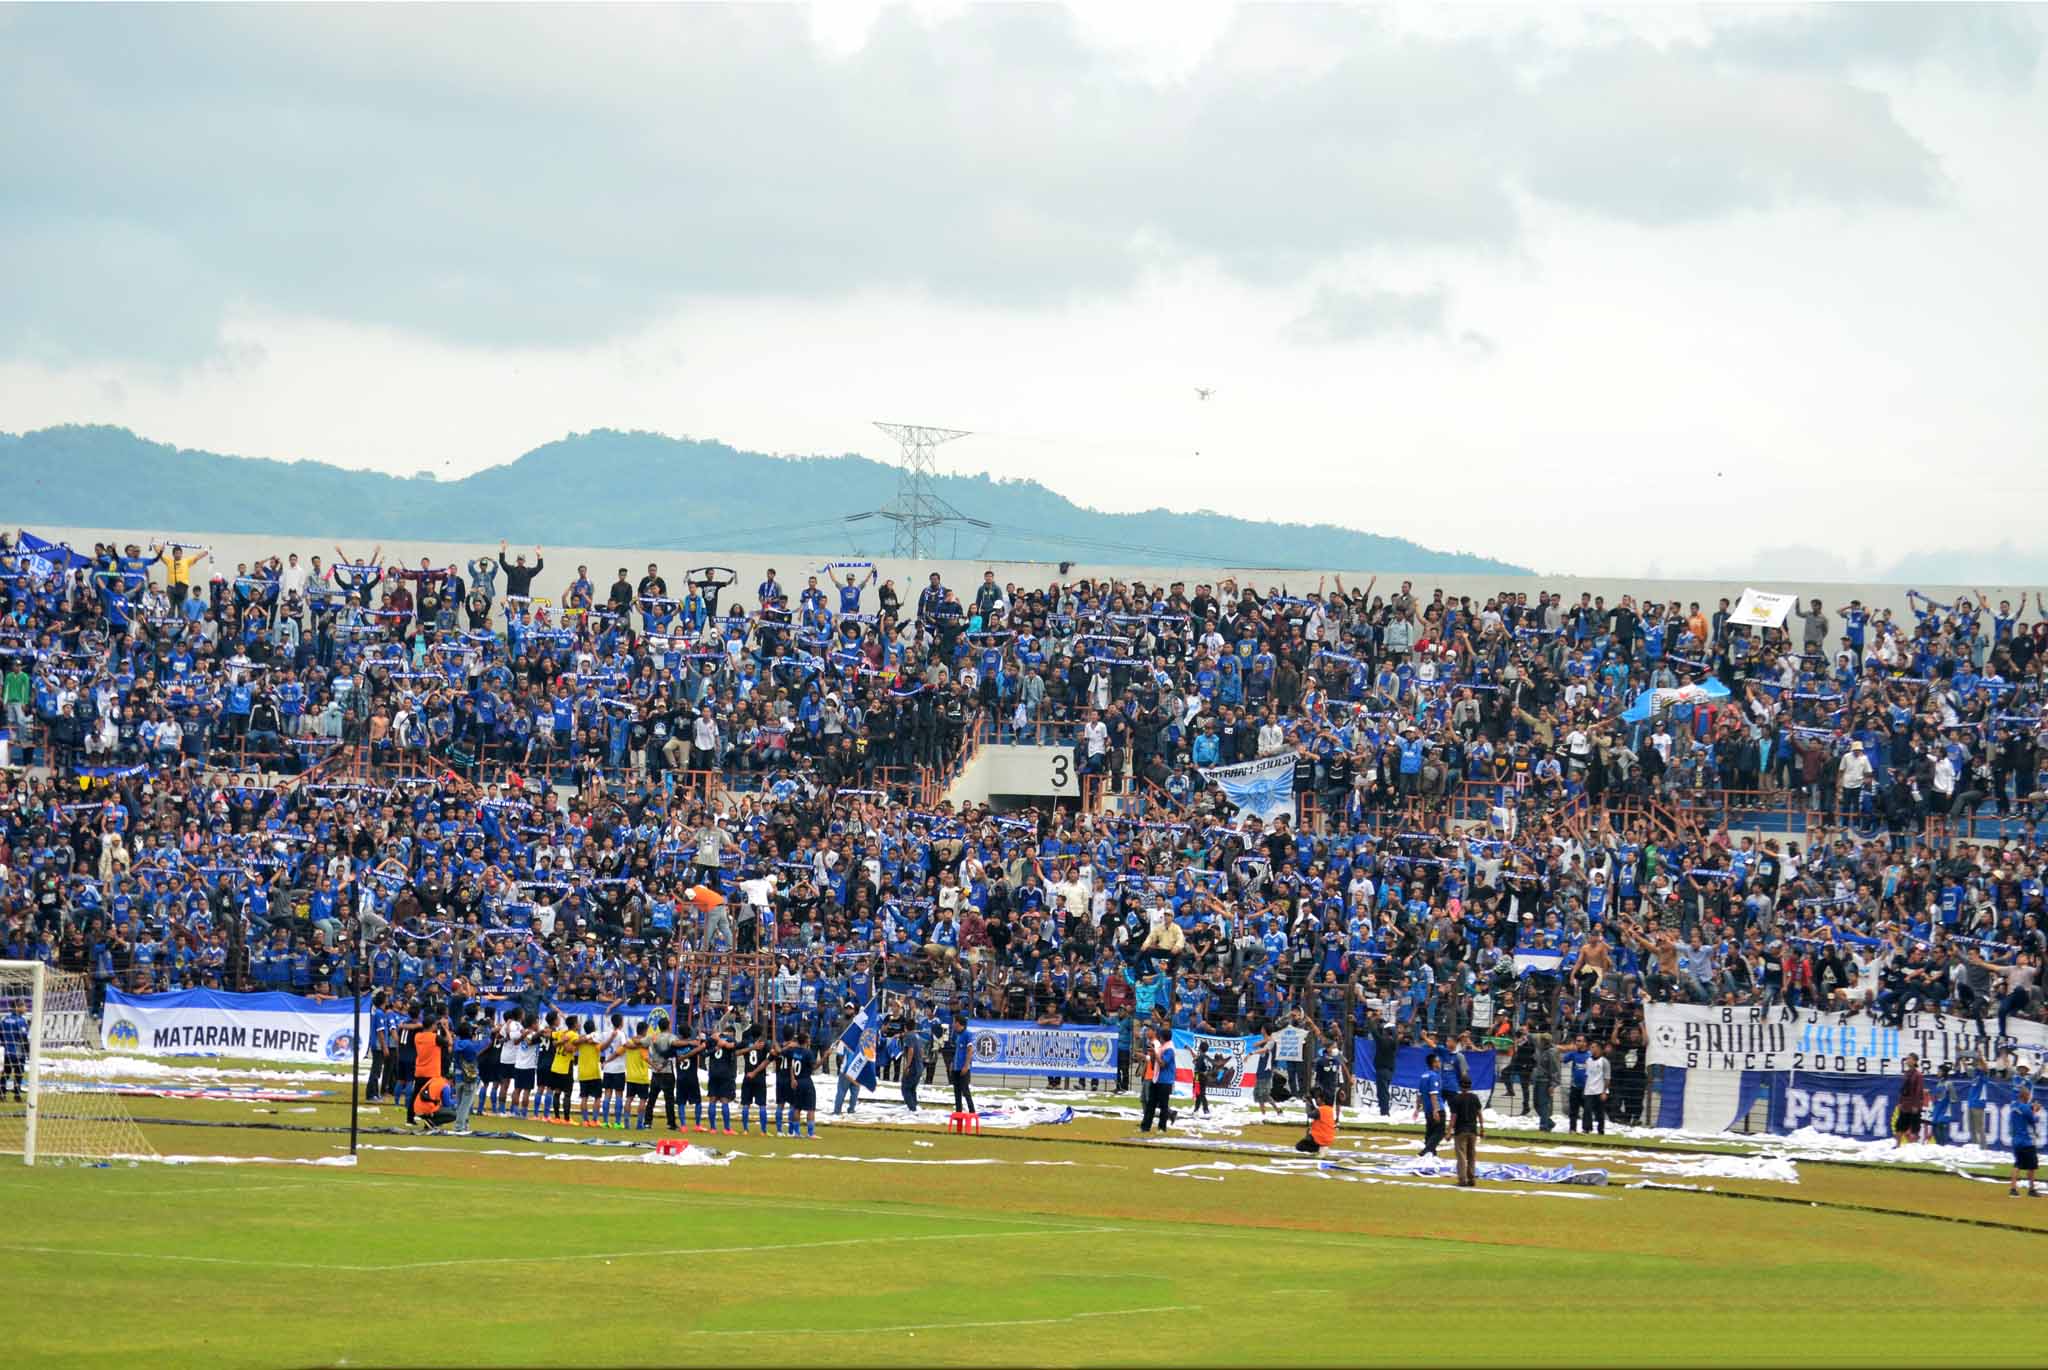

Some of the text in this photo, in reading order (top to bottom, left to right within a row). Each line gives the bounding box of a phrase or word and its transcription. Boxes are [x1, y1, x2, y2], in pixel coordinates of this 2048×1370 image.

[1051, 754, 1069, 787] 3
[153, 1026, 320, 1053] MATARAM EMPIRE
[1687, 1053, 1775, 1069] SINCE
[1793, 1053, 1867, 1073] 2008
[1355, 1080, 1419, 1102] MARAM
[1784, 1087, 1889, 1138] PSIM
